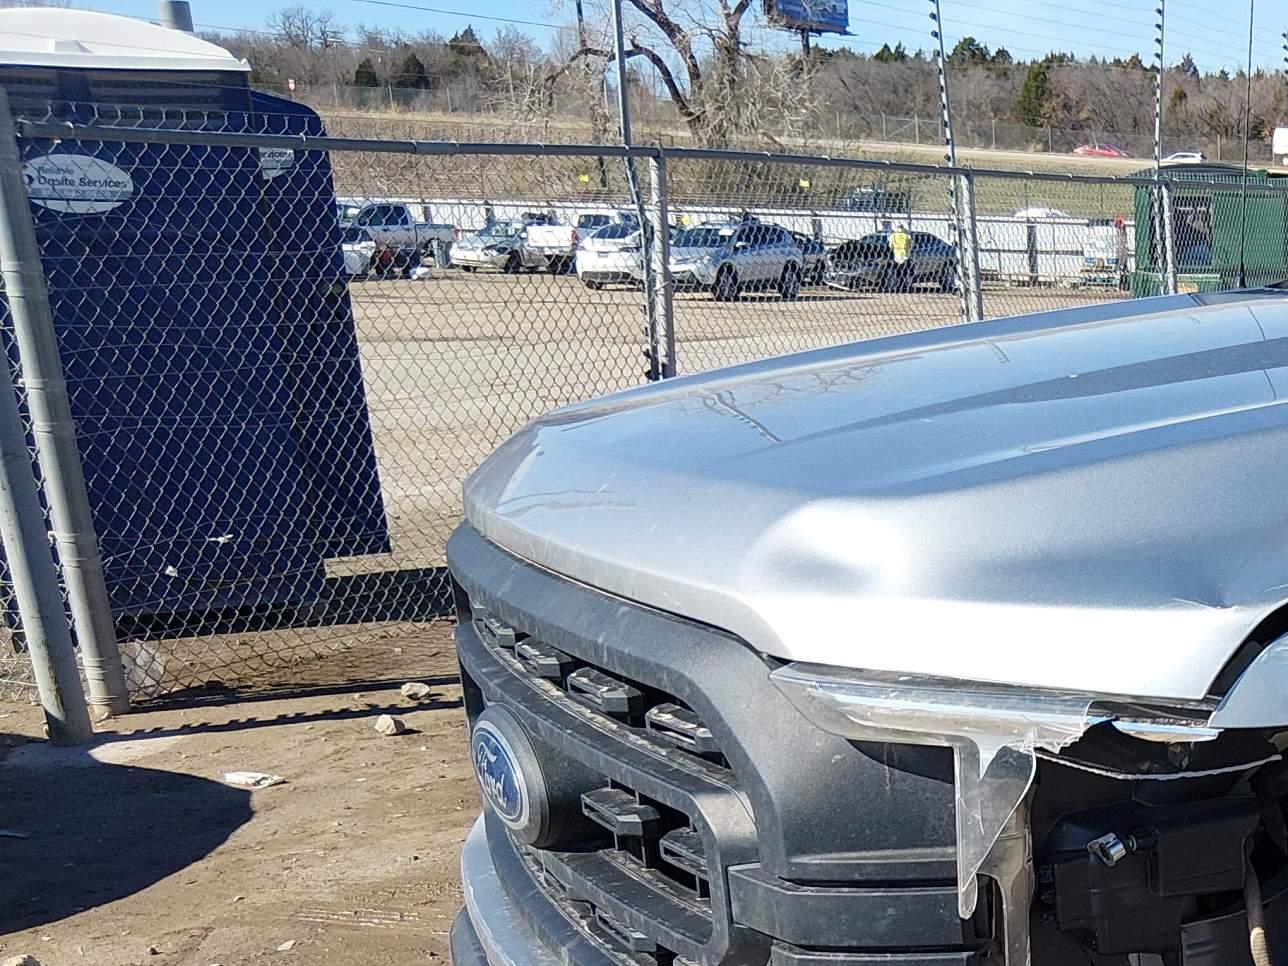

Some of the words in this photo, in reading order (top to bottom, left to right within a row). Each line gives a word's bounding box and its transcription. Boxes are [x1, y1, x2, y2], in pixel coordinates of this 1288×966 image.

[38, 175, 76, 187] Onsite
[78, 177, 127, 188] Services
[478, 741, 508, 809] Ford
